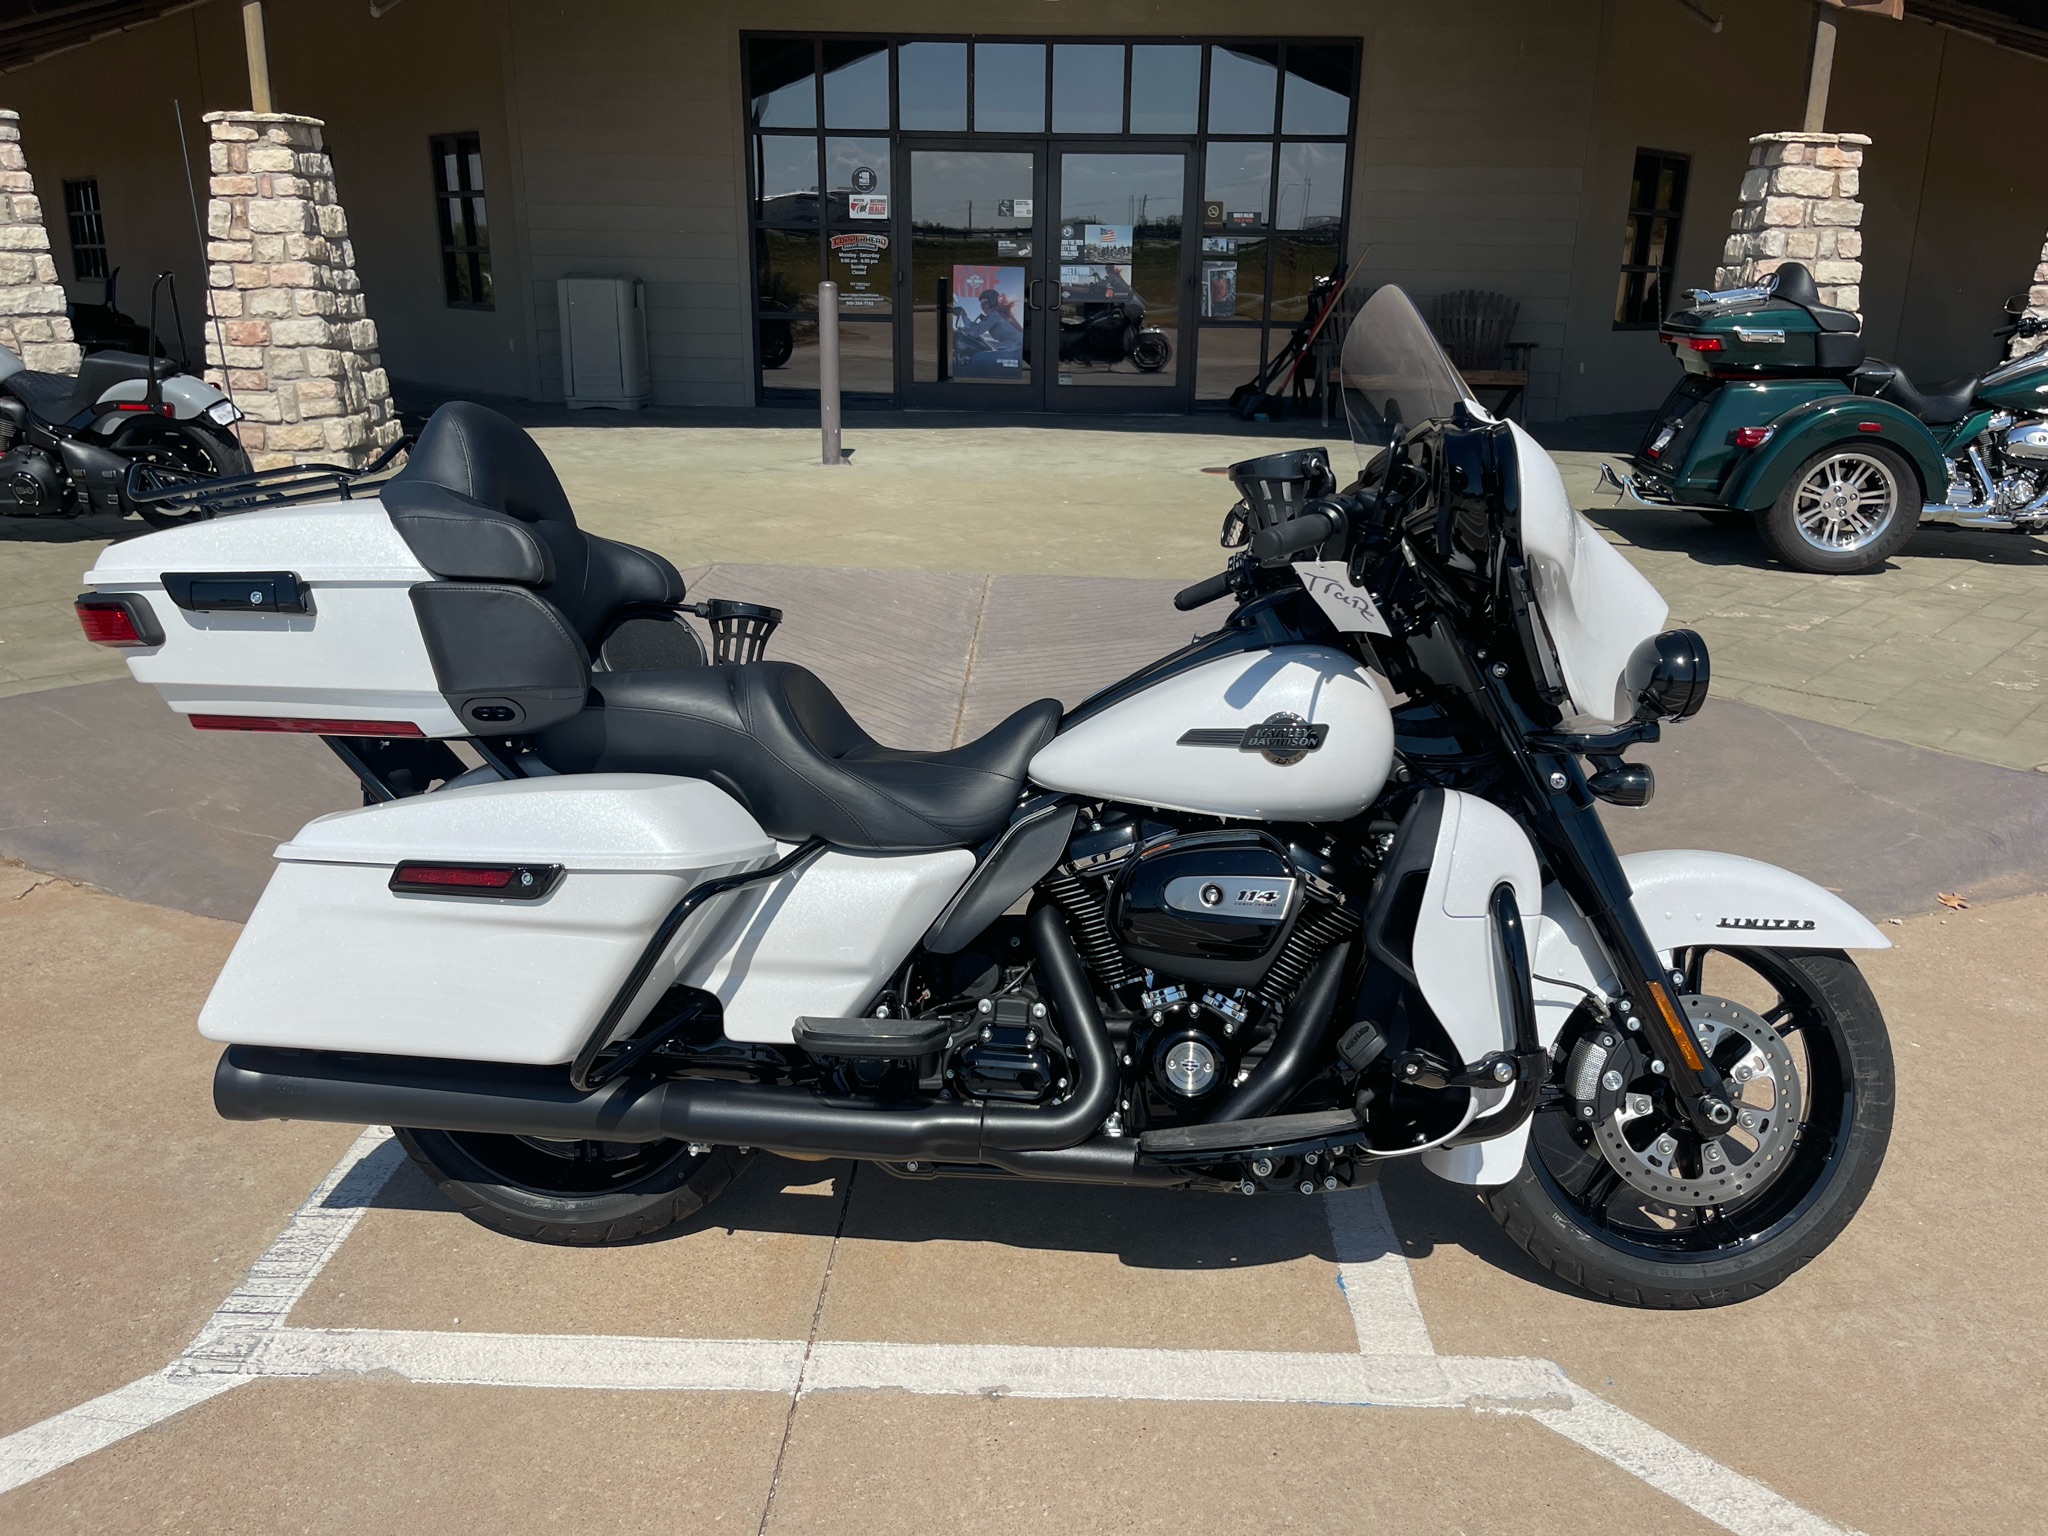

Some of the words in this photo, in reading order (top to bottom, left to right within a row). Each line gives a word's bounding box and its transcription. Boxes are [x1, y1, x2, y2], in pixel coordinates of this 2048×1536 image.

[832, 235, 888, 247] COPPERHEAD
[953, 265, 1001, 298] RIDE
[1248, 738, 1318, 746] DAVIDSON
[1236, 889, 1281, 903] 114
[1716, 917, 1816, 931] LIMITED
